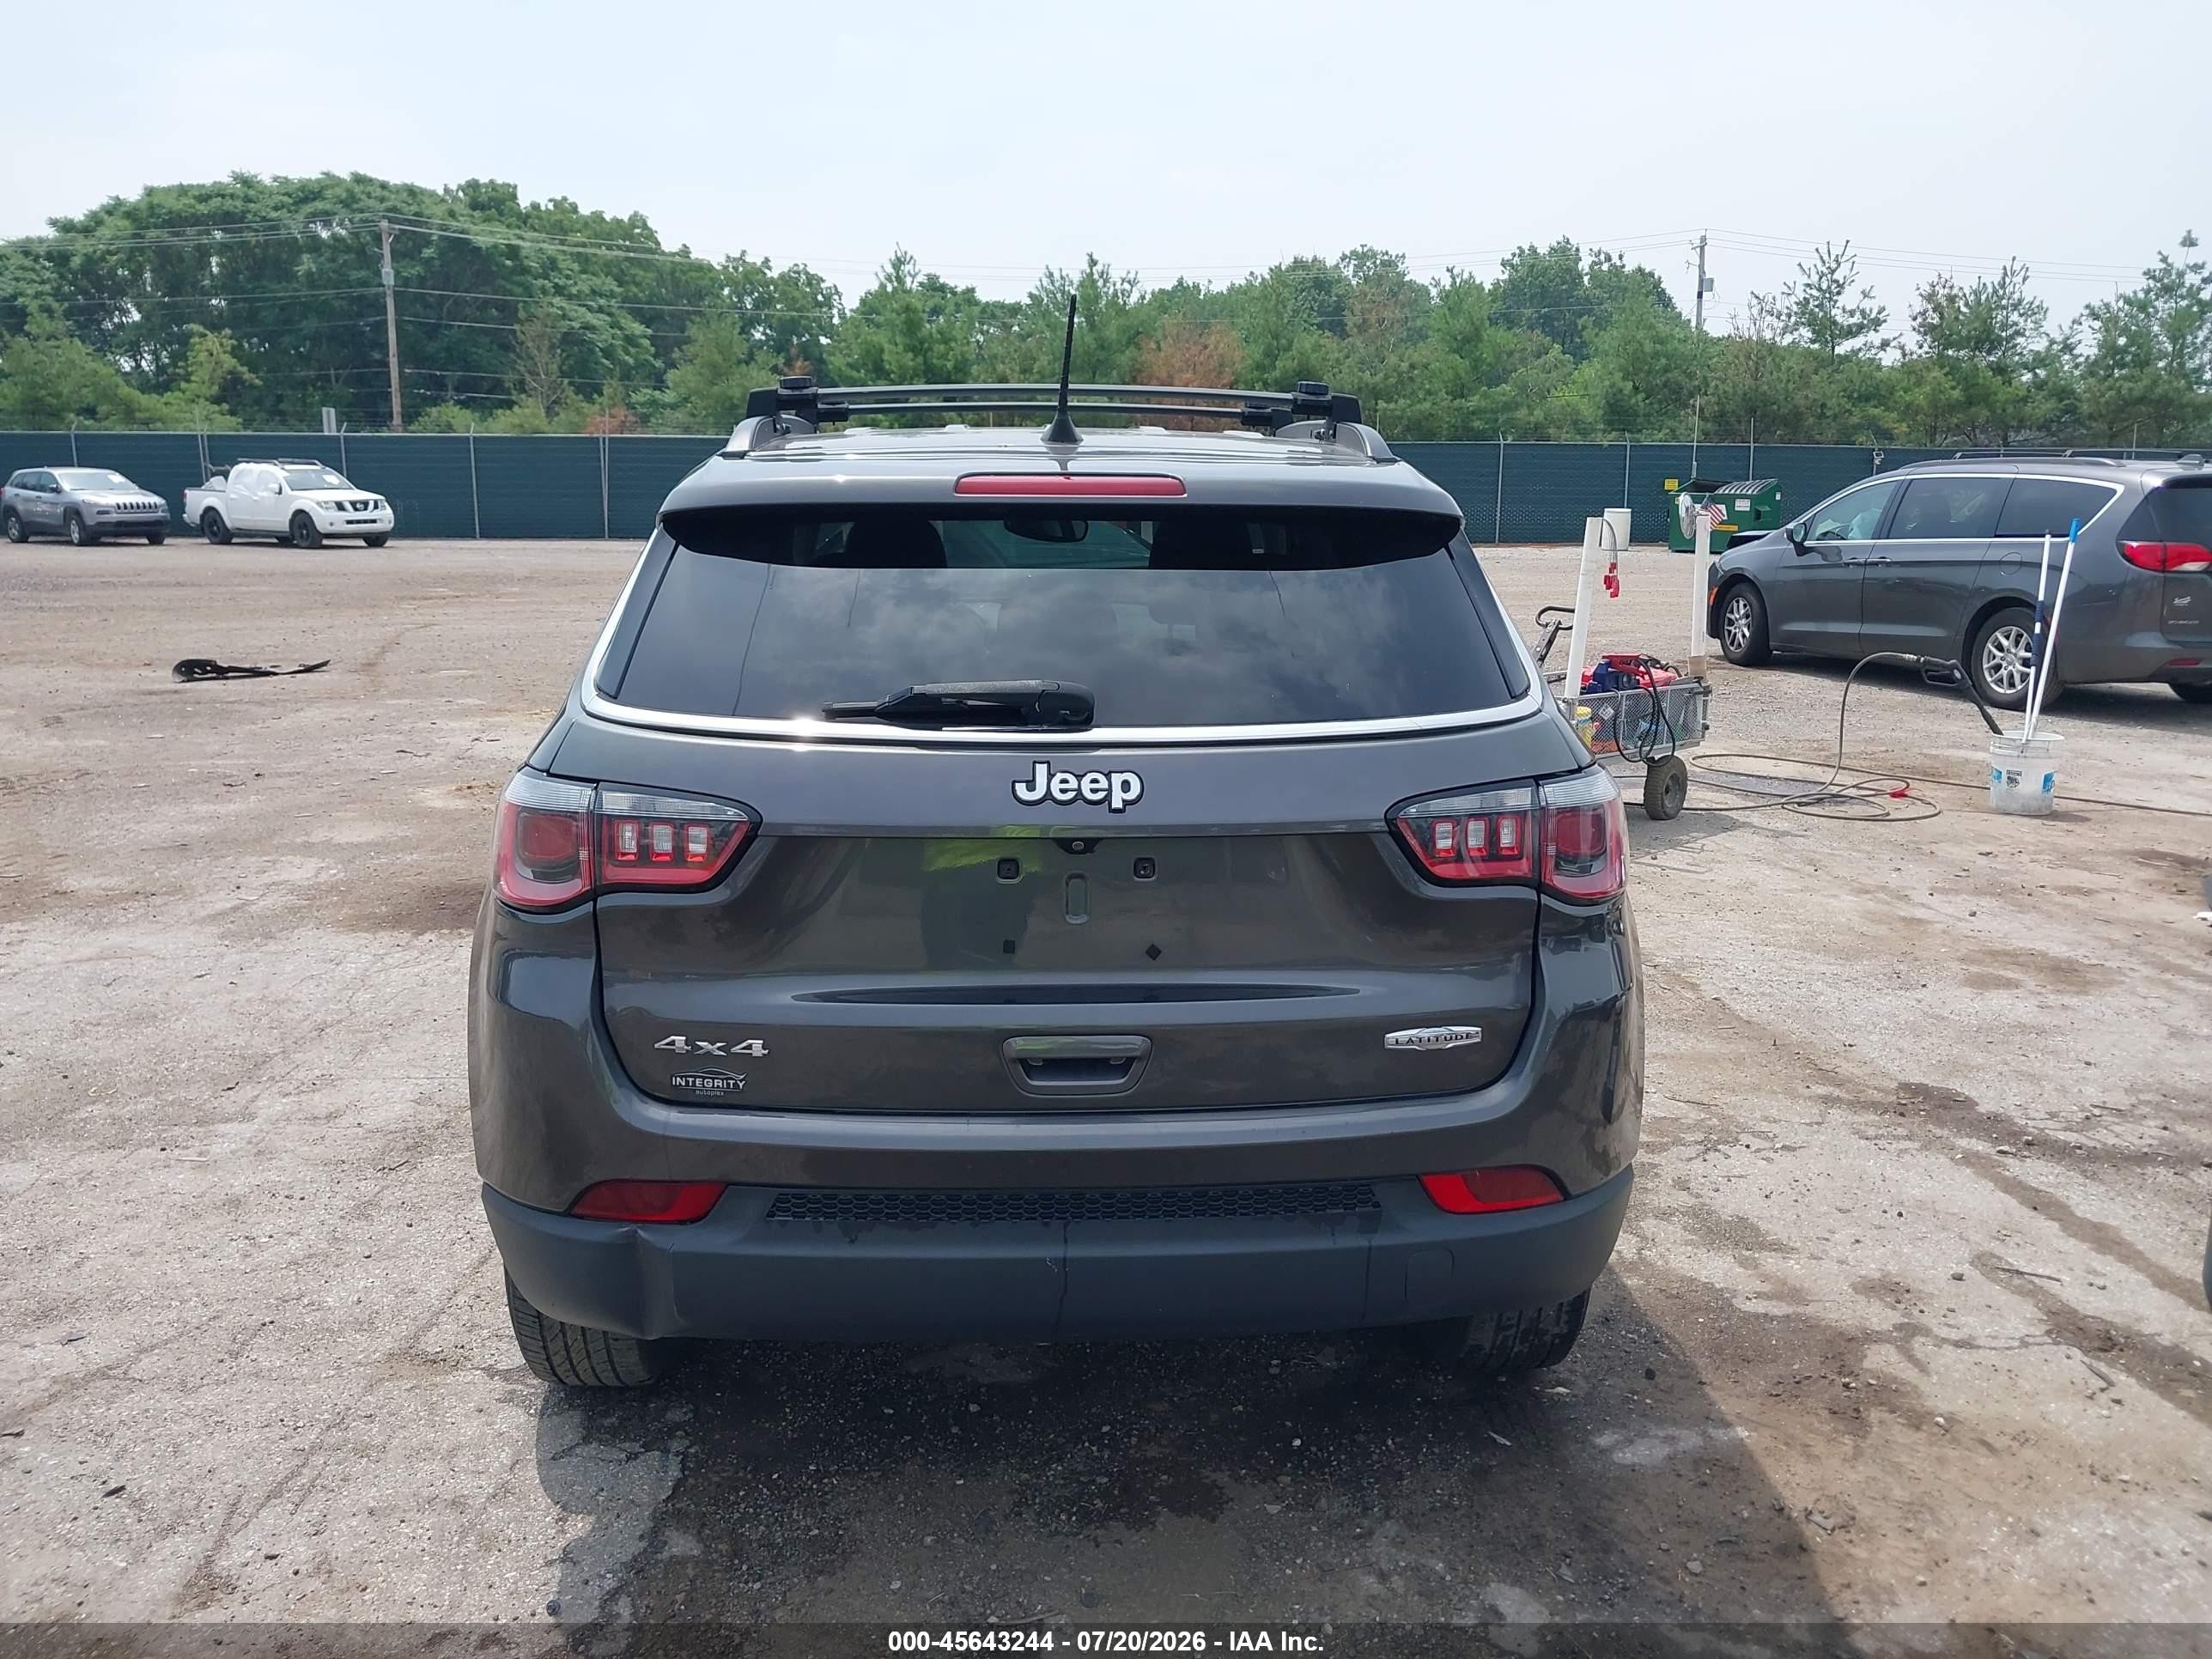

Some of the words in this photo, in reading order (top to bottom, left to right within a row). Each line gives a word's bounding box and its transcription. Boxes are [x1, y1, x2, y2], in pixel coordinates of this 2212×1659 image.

[1012, 761, 1143, 812] Jeep
[653, 1035, 769, 1057] 4x4
[1394, 1030, 1480, 1045] LATITUDE
[672, 1076, 746, 1090] INTEGRITY
